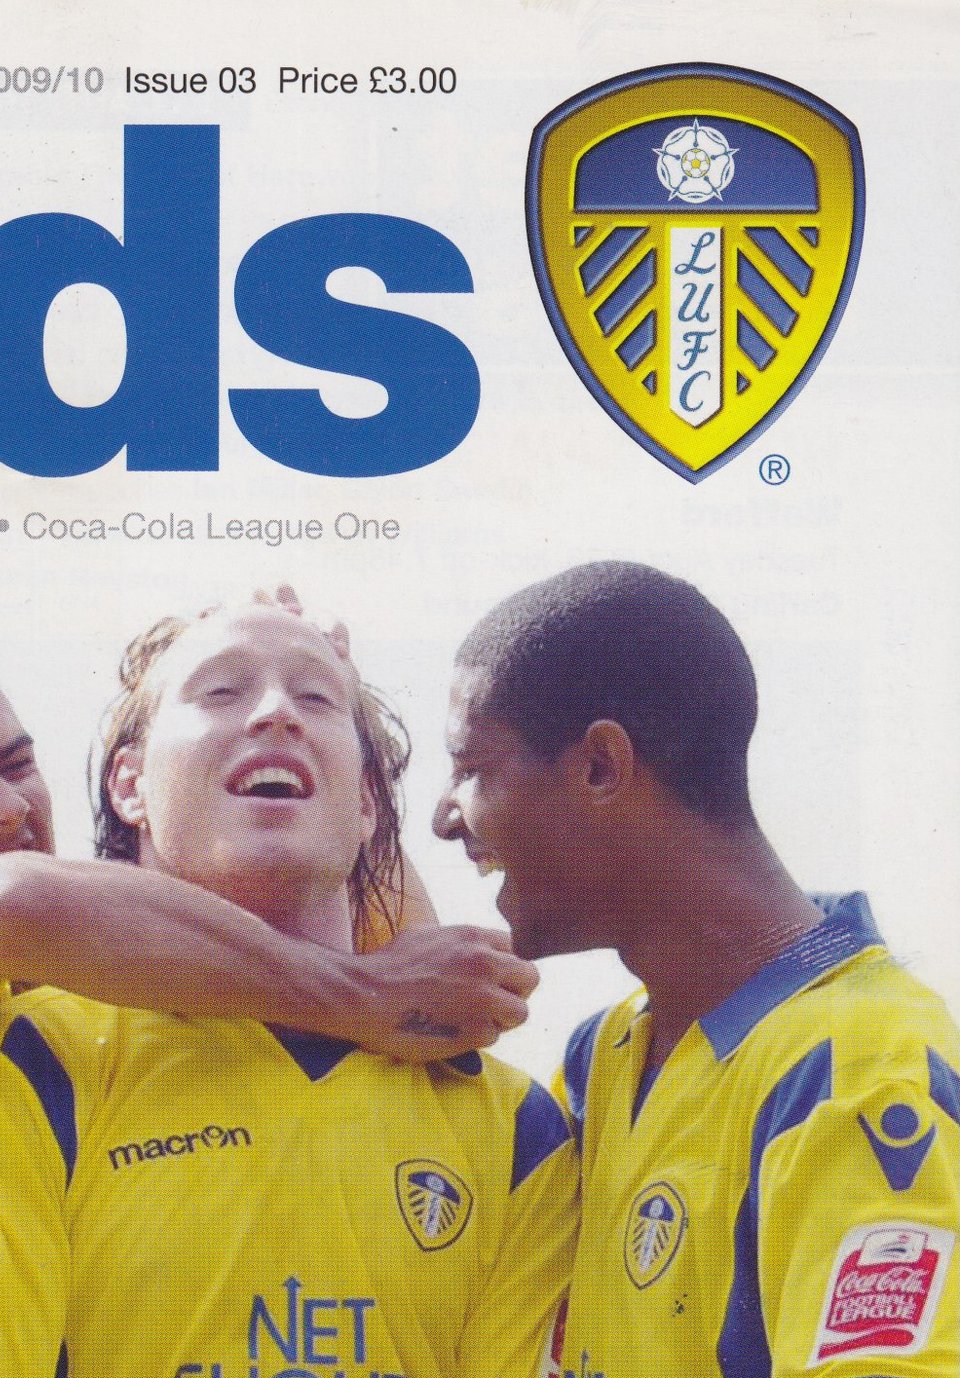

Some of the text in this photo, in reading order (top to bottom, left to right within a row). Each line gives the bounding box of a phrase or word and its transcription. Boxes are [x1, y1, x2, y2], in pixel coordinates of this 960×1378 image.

[124, 67, 210, 95] Issue
[218, 67, 258, 95] 03
[279, 67, 359, 95] Price
[369, 67, 458, 96] £3.00
[22, 512, 196, 541] Coca-Cola
[207, 512, 325, 548] League
[334, 513, 401, 541] One
[248, 1275, 375, 1364] NET
